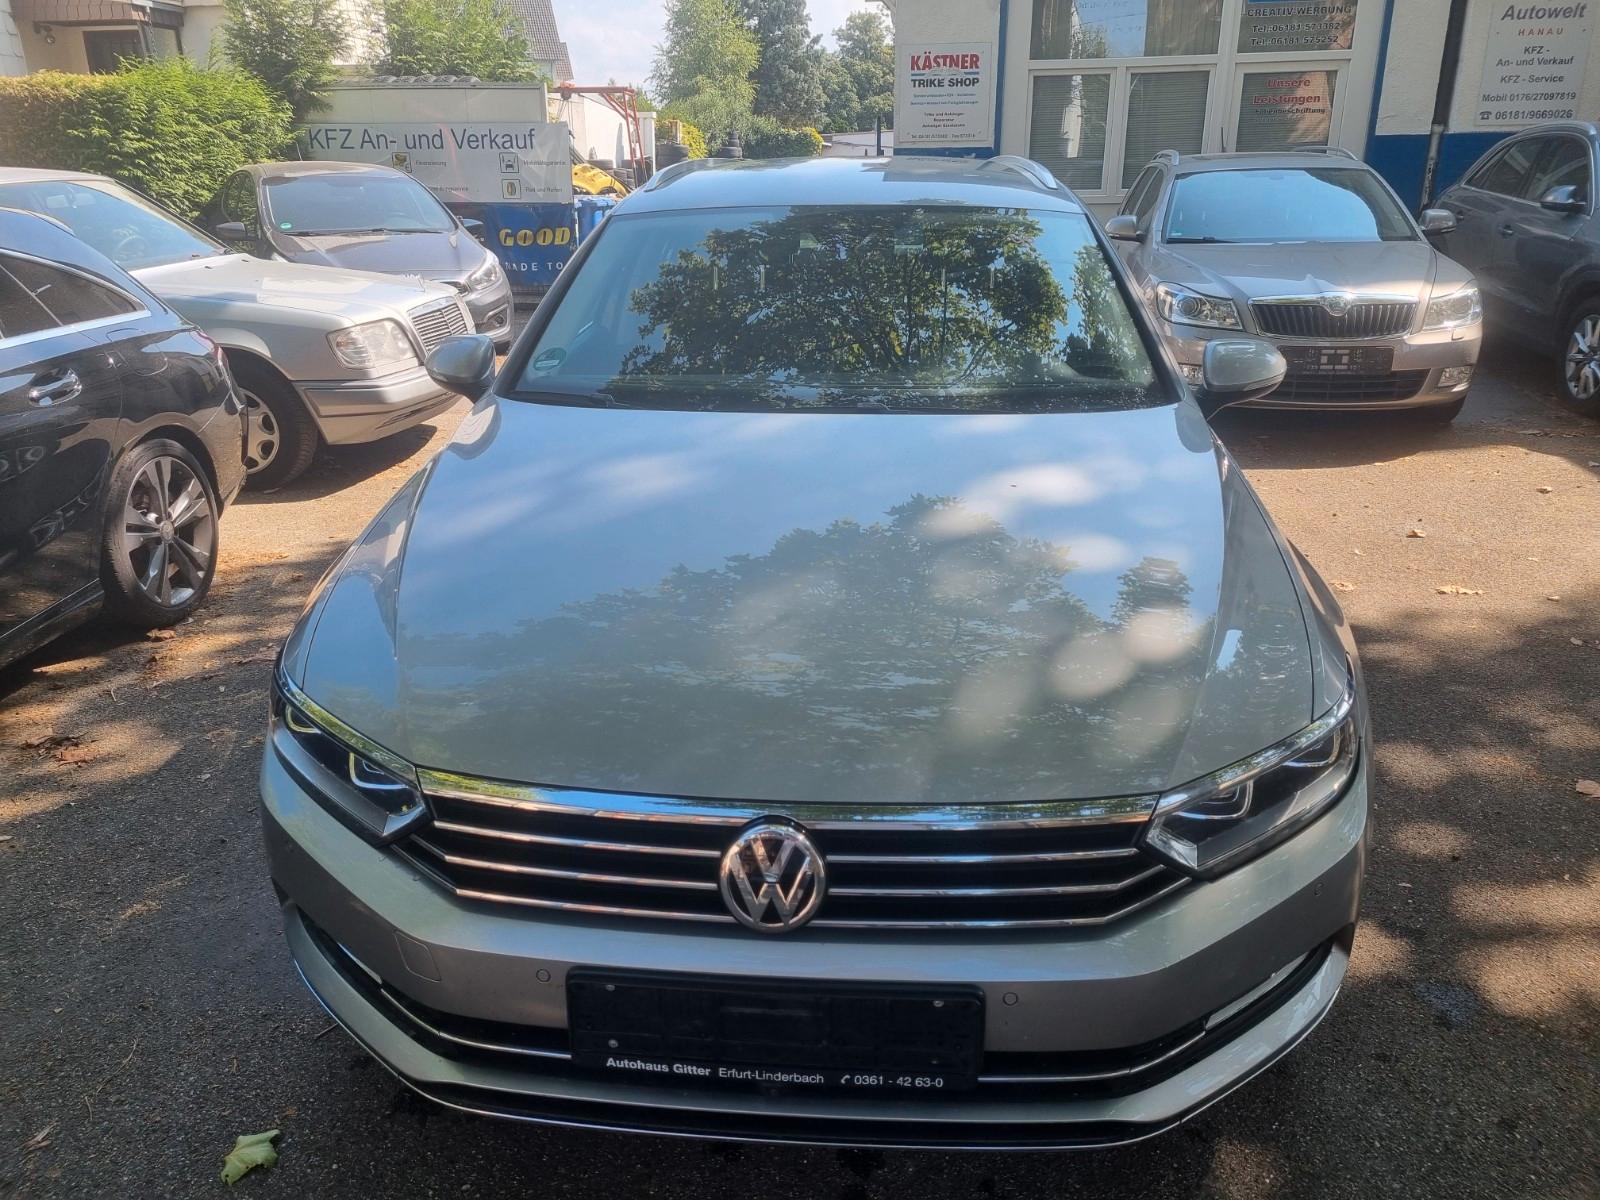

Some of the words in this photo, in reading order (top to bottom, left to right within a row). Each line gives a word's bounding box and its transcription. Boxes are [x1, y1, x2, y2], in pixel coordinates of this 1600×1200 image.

[1247, 6, 1352, 16] CREATIV-WERBUNG
[1501, 3, 1587, 20] Autowelt
[1518, 27, 1564, 36] HANAU
[1523, 46, 1544, 54] KFZ
[911, 51, 980, 70] KÄSTNER
[1496, 59, 1513, 67] An-
[1515, 58, 1534, 66] und
[1537, 56, 1574, 65] Verkauf
[911, 79, 945, 88] TRIKE
[948, 78, 980, 87] SHOP
[1267, 79, 1311, 88] Unsere
[1500, 75, 1520, 84] KFZ
[1528, 75, 1565, 83] Service
[1253, 95, 1321, 105] Leistungen
[1482, 94, 1507, 102] Mobil
[1509, 92, 1576, 102] 0176/27097819
[1494, 110, 1574, 120] 06181/9669026
[309, 128, 355, 149] KFZ
[360, 129, 397, 149] An-
[404, 129, 444, 149] und
[450, 128, 536, 149] Verkauf
[499, 228, 571, 247] GOOD
[547, 262, 564, 270] TO
[606, 1057, 669, 1073] Autohaus
[673, 1063, 711, 1076] Gitter
[718, 1067, 825, 1084] Erfurt-Linderbach
[854, 1075, 883, 1085] 0361
[896, 1077, 911, 1087] 42
[915, 1078, 944, 1088] 63-0
